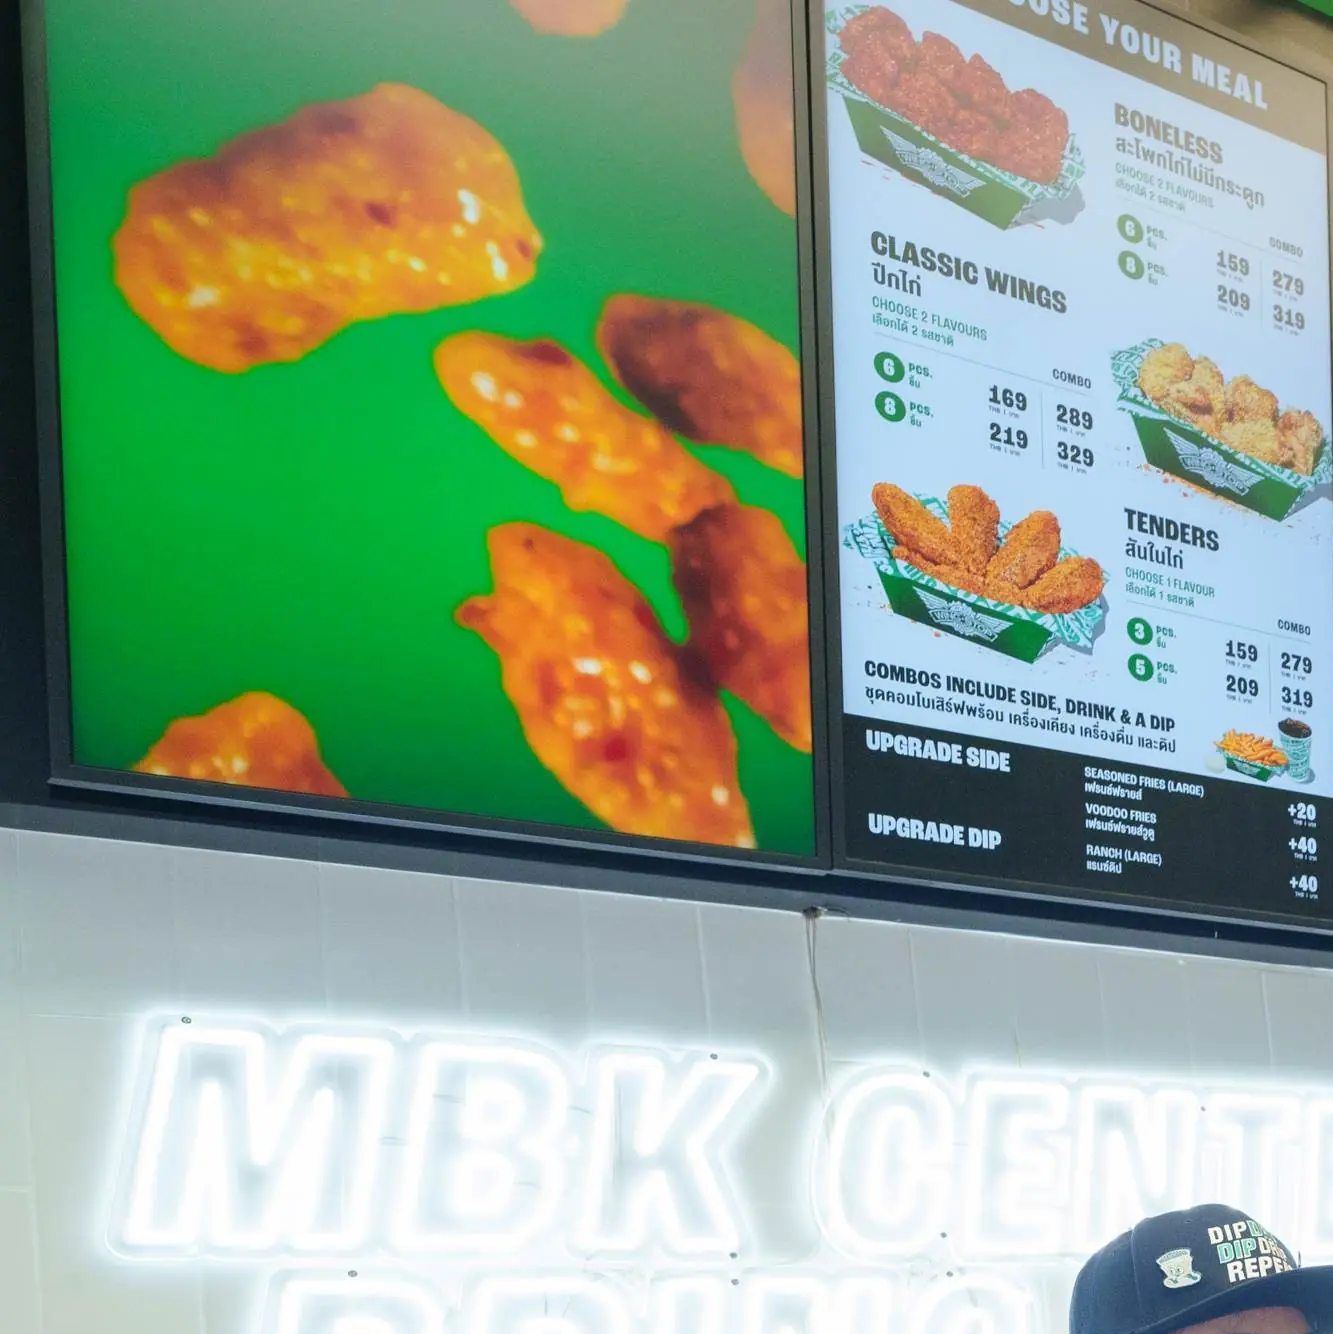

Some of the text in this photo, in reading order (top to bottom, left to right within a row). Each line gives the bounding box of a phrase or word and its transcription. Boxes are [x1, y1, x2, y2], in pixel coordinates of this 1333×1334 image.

[1099, 13, 1182, 74] YOUR
[1191, 53, 1268, 110] MEAL
[1114, 102, 1224, 164] BONELESS
[1269, 236, 1304, 258] COMBO
[870, 231, 1067, 314] CLASSIC WINGS
[1217, 250, 1250, 276] 159
[871, 261, 922, 297] ปีกไก่
[1272, 270, 1304, 296] 279
[1217, 284, 1250, 311] 209
[872, 295, 987, 341] CHOOSE FLAVOURS
[1273, 304, 1305, 330] 319
[1052, 368, 1092, 389] COMBO
[988, 384, 1028, 412] 169
[1056, 404, 1093, 431] 289
[989, 422, 1028, 449] 219
[1057, 441, 1094, 468] 329
[1124, 508, 1220, 551] TENDERS
[1125, 537, 1184, 570] สันในไก่
[1125, 567, 1215, 598] CHOOSE FLAVOUR
[1277, 619, 1311, 636] COMBO
[1225, 640, 1258, 662] 159
[1280, 652, 1312, 675] 279
[864, 660, 1175, 733] COMBOS INCLUDE SIDE, DRINK & A DIP
[1226, 675, 1259, 697] 209
[1281, 686, 1313, 708] 319
[865, 686, 1176, 753] ชุดคอมโบเสิร์ฟพร้อม เครื่องเคียง เครื่องดื่ม และดิป
[865, 729, 1011, 773] UPGRADE SIDE
[1084, 767, 1205, 798] SEASONED FRIES (LARGE)
[1085, 802, 1157, 824] VOODOO FRIES
[1288, 803, 1316, 821] +20
[868, 813, 1002, 850] UPGRADE DIP
[1289, 836, 1317, 854] +40
[1086, 844, 1162, 867] RANCH (LARGE)
[1290, 875, 1318, 892] +40
[115, 1018, 765, 1258] MBK
[1207, 1221, 1247, 1245] DIP
[1217, 1238, 1257, 1264] DIP
[1227, 1256, 1293, 1283] REPE
